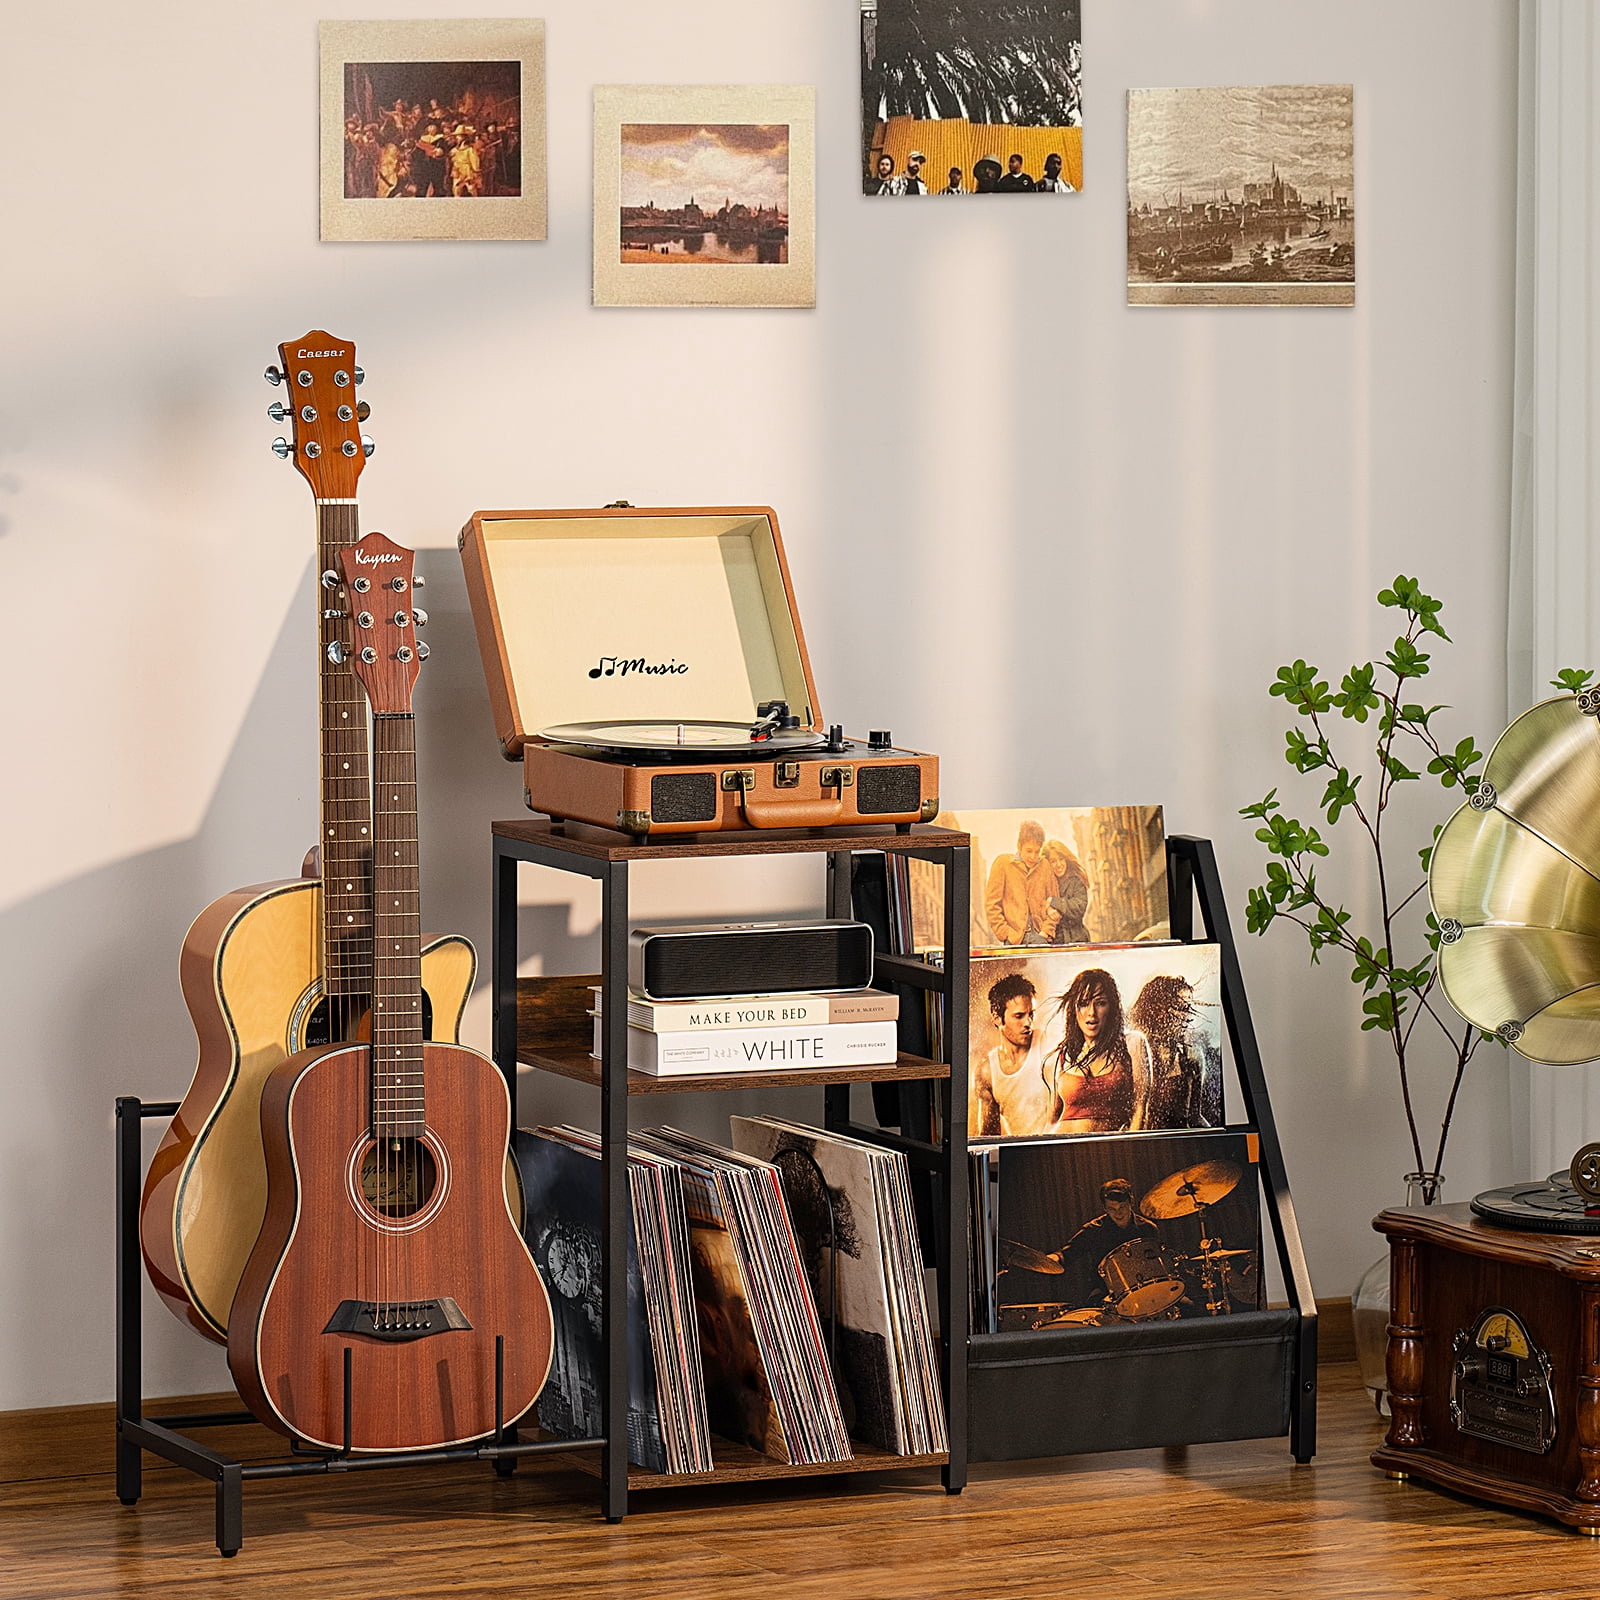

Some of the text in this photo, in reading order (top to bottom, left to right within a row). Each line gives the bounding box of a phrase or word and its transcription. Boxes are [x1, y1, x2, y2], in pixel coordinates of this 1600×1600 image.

[297, 349, 345, 358] Caesar
[355, 548, 403, 569] Kaysen
[616, 657, 689, 676] Music
[689, 1007, 807, 1025] MAKE YOUR BED
[742, 1038, 824, 1061] WHITE
